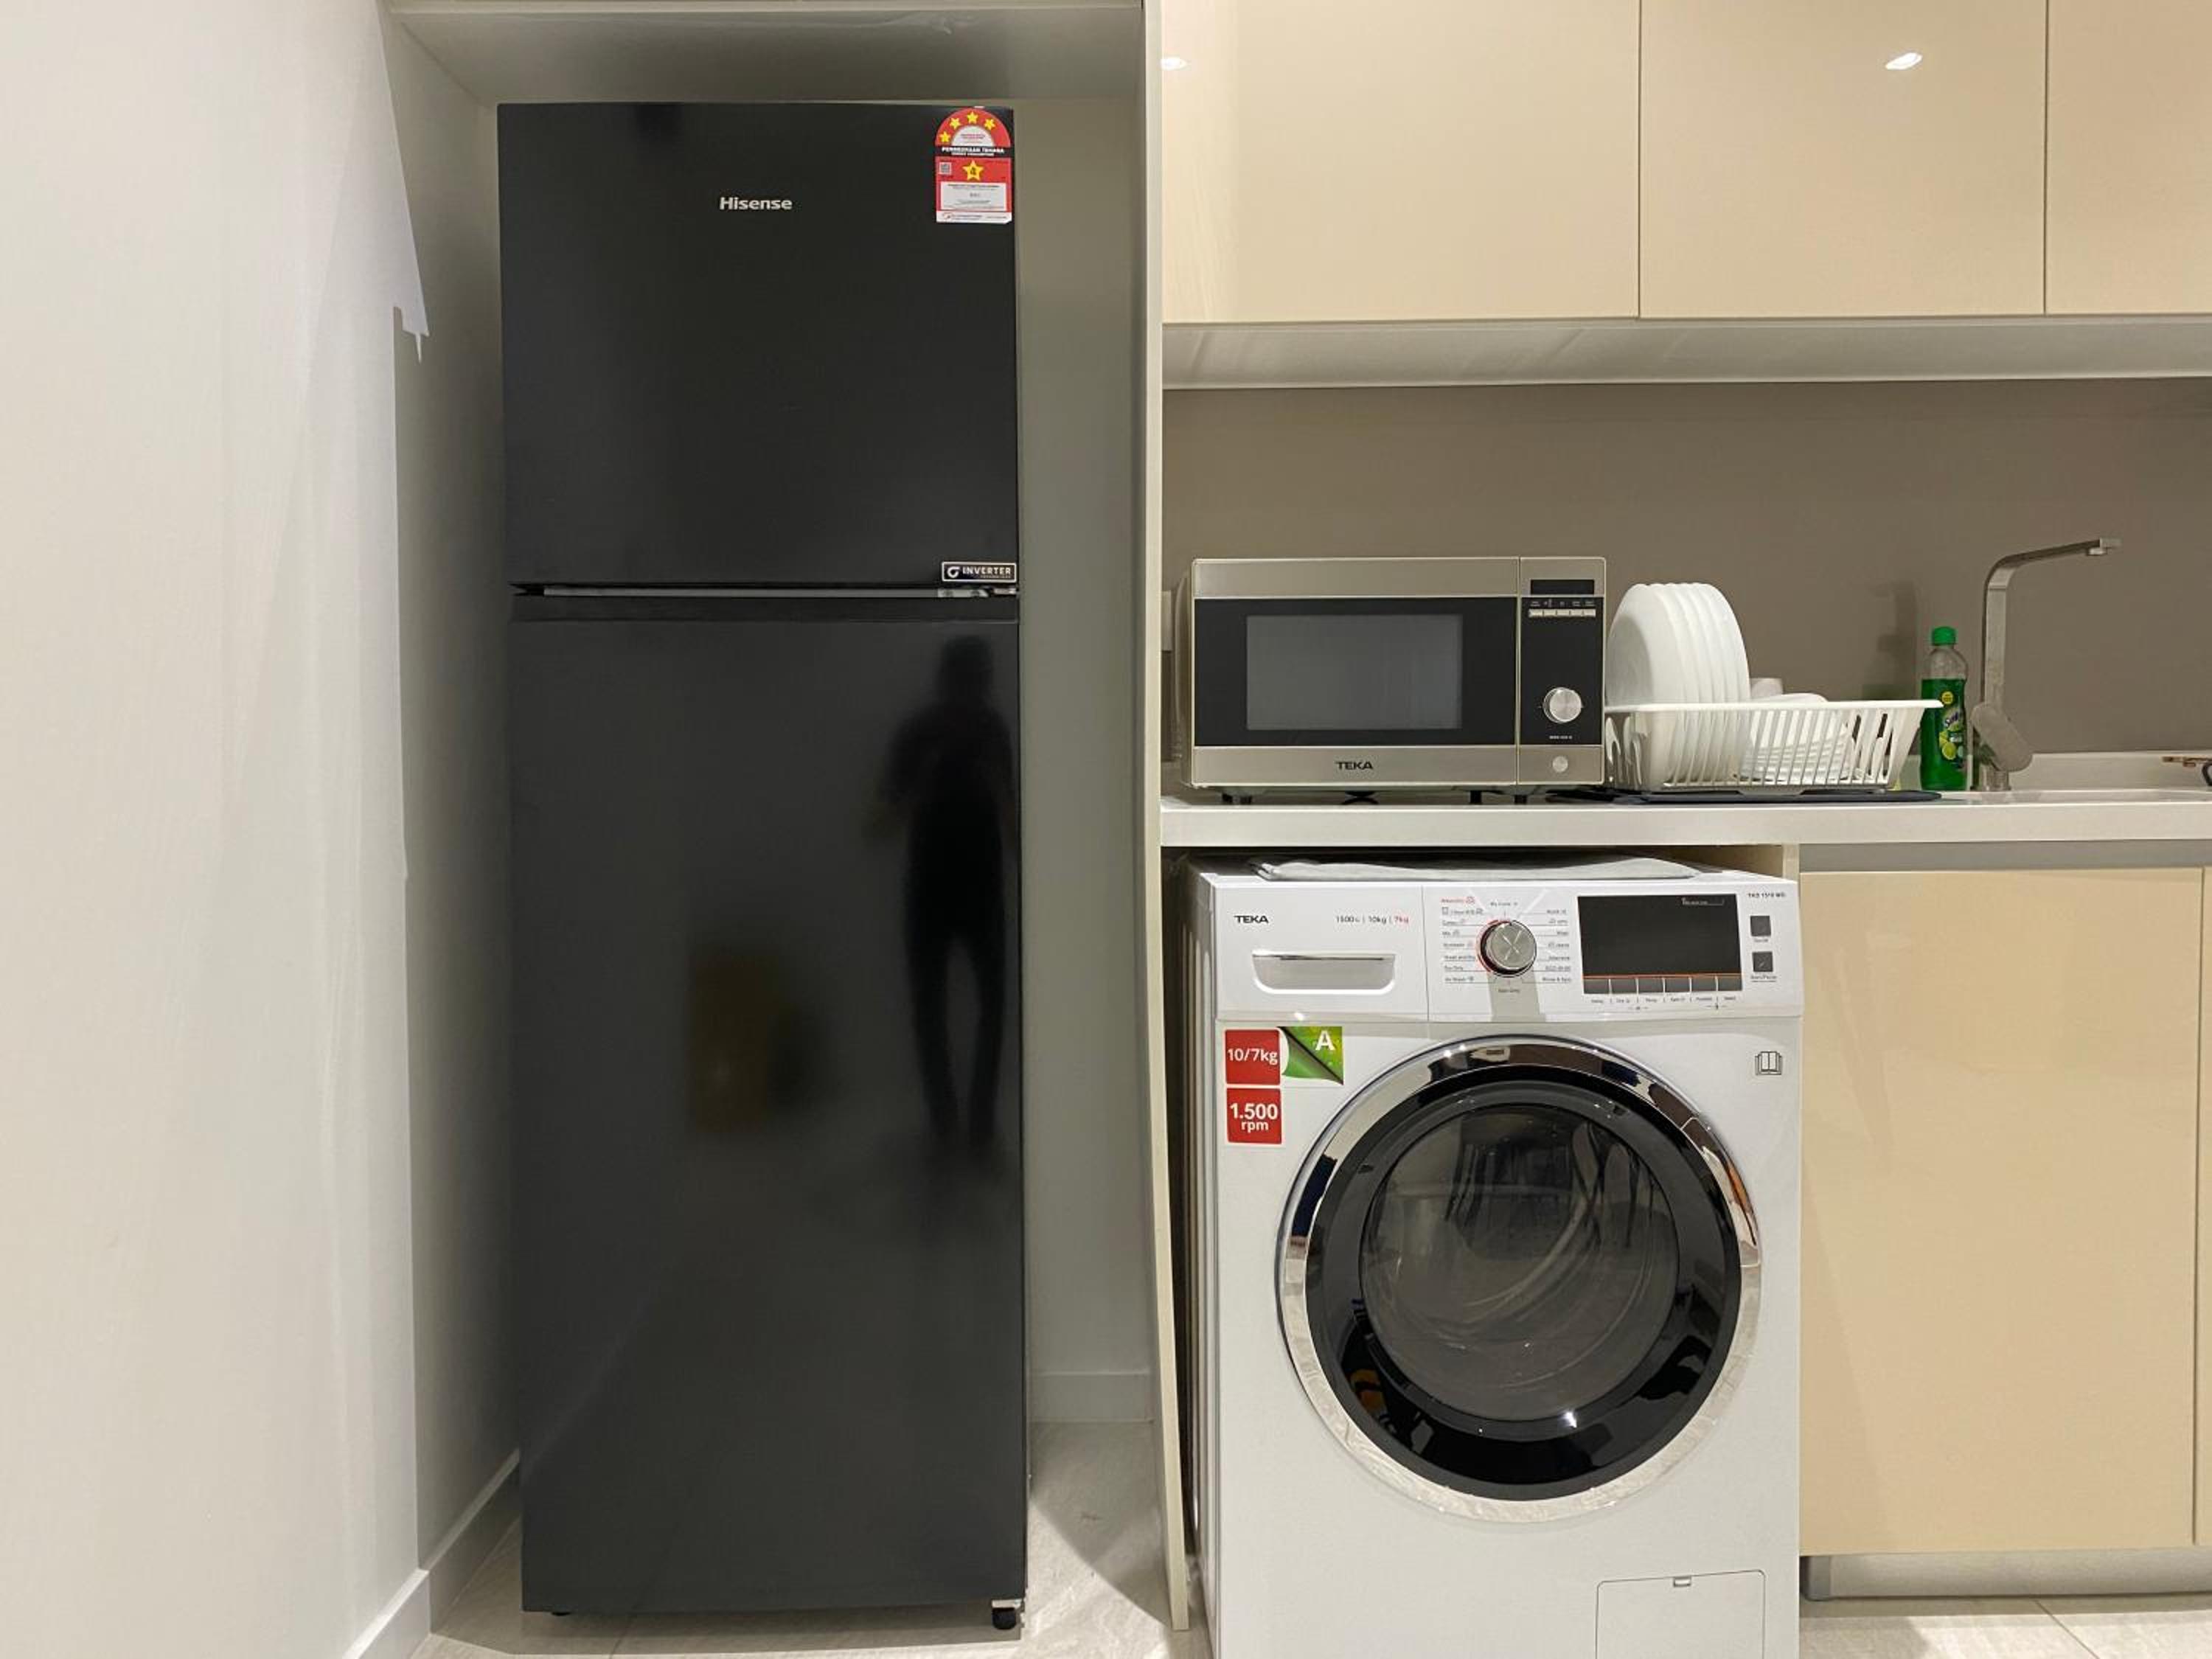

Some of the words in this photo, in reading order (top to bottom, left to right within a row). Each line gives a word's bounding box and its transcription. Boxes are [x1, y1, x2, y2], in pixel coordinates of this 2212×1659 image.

[720, 197, 793, 209] Hisense
[962, 566, 1011, 574] INVERTER
[1335, 761, 1374, 770] TEKA
[1234, 915, 1269, 923] TEKA
[1368, 914, 1387, 924] 10kg
[1315, 1030, 1335, 1051] A
[1227, 1048, 1279, 1065] 10/7kg
[1229, 1103, 1279, 1120] 1.500
[1241, 1121, 1269, 1133] rpm
